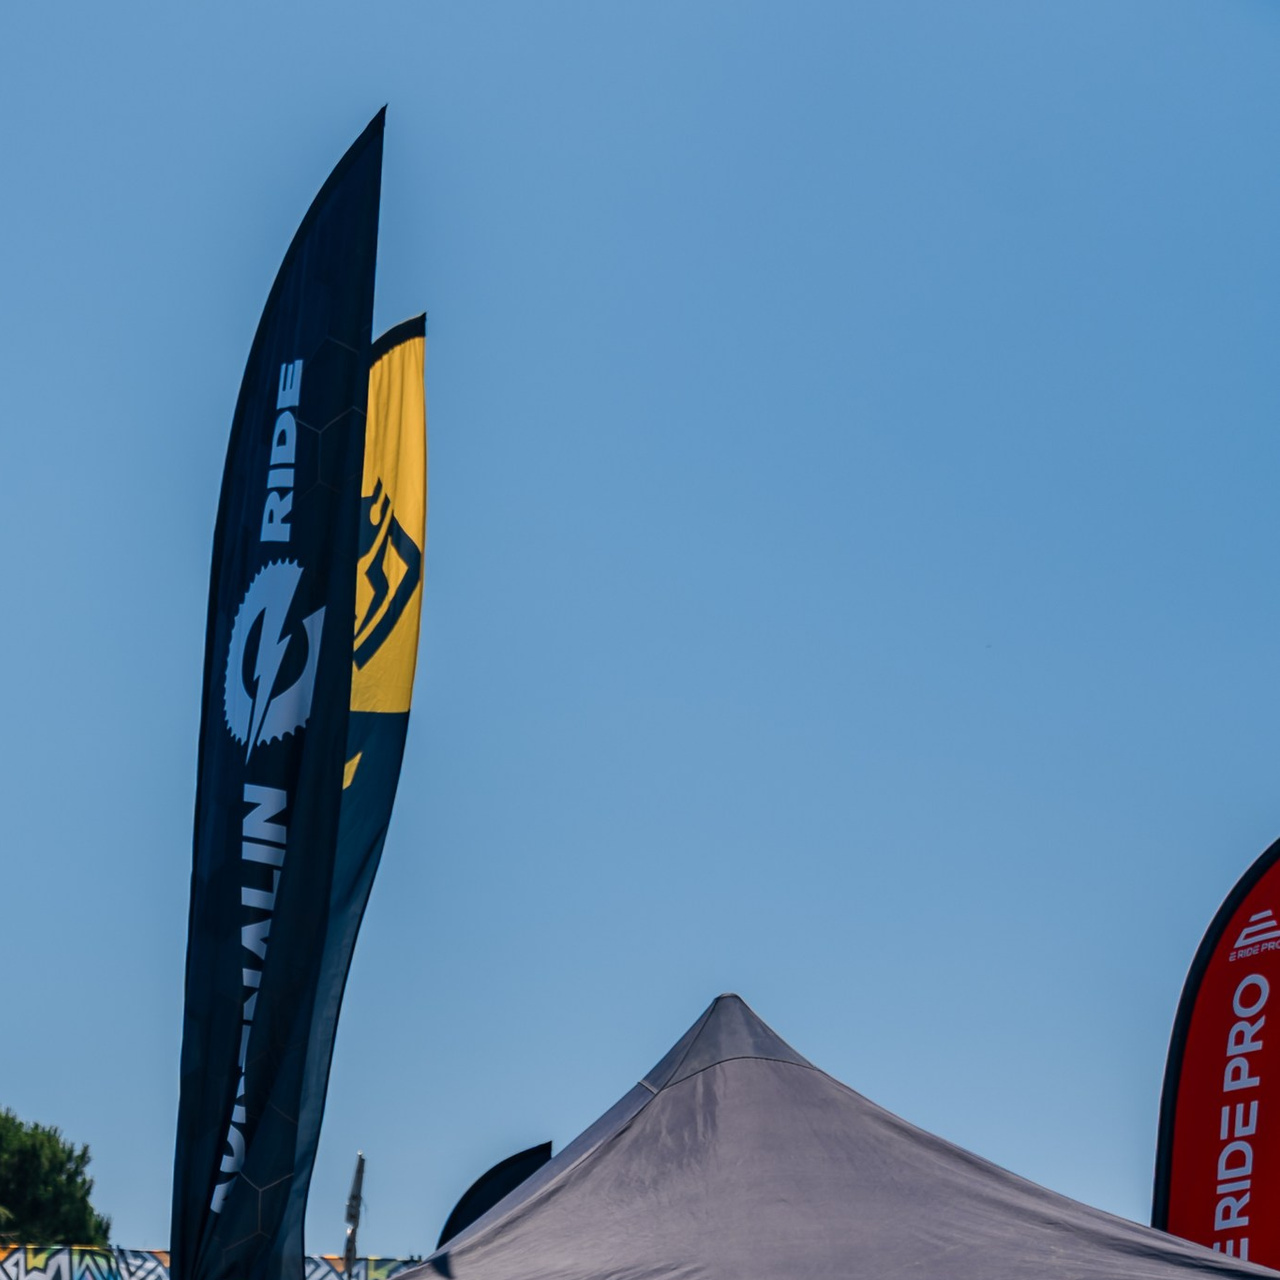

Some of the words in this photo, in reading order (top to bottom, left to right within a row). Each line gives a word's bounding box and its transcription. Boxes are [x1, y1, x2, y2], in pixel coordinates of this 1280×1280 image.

[260, 359, 303, 542] RIDE
[1237, 944, 1260, 960] RIDE
[1223, 974, 1270, 1092] PRO
[1214, 1100, 1259, 1232] RIDE
